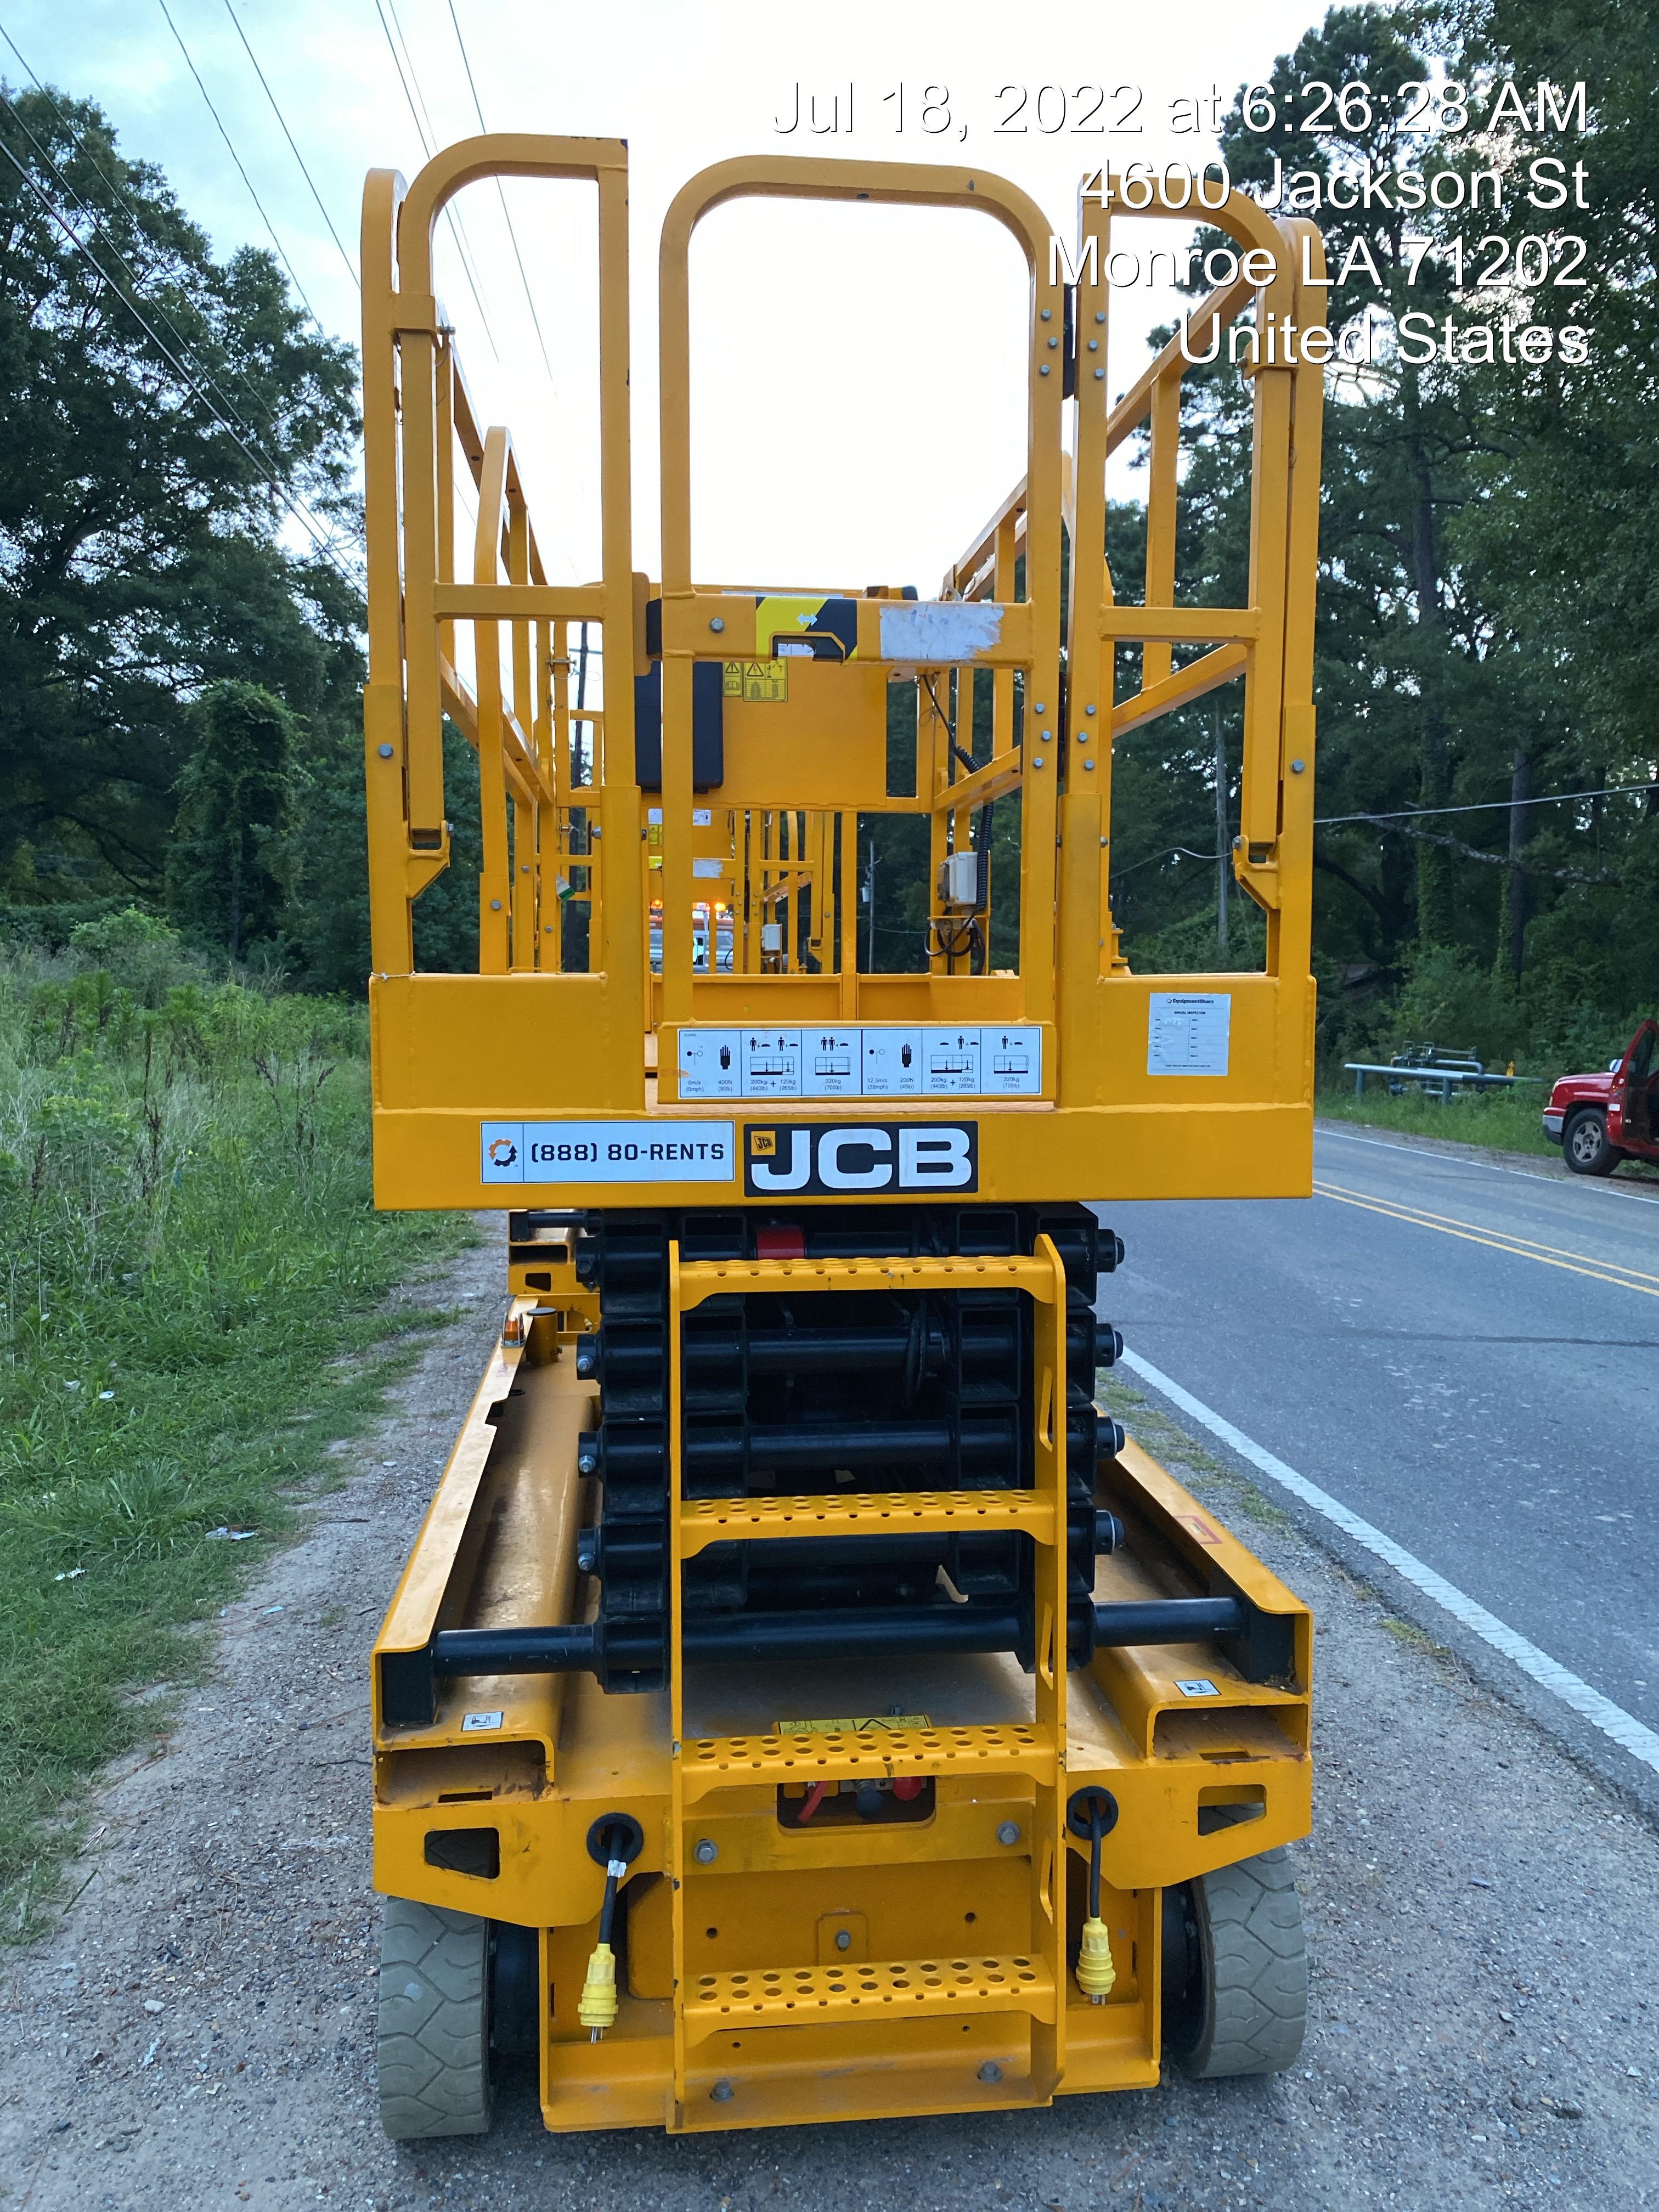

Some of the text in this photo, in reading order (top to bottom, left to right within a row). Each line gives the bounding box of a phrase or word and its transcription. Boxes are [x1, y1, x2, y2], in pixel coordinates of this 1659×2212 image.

[532, 1143, 724, 1163] (888) 80-RENTS
[757, 1136, 772, 1150] JCB
[751, 1128, 972, 1190] JCB
